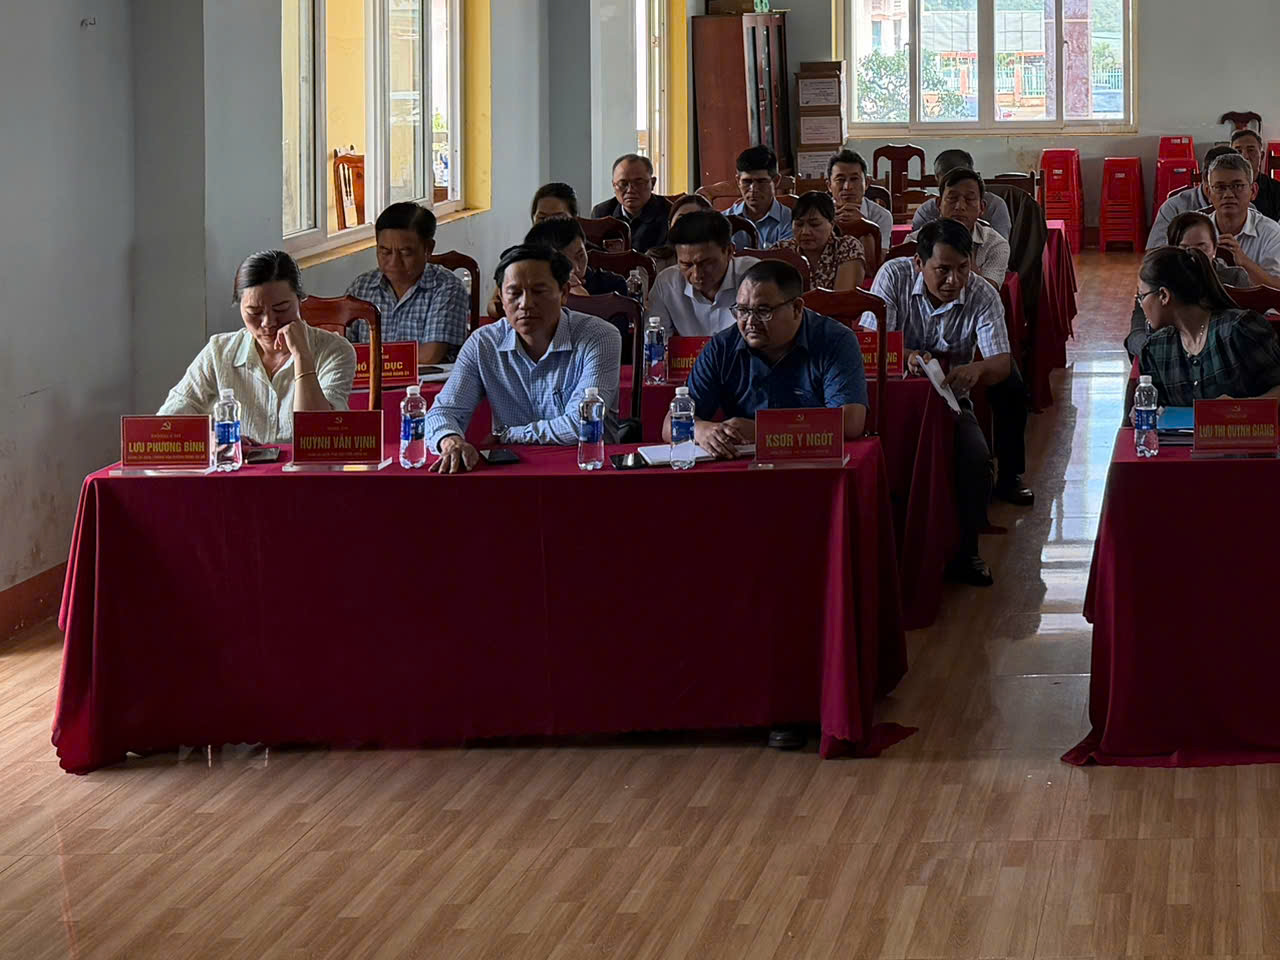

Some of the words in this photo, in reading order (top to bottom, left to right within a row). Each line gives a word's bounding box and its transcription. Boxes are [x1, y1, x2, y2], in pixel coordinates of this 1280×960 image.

[146, 441, 182, 453] PHƯƠNG
[183, 439, 205, 453] BÌNH
[796, 432, 803, 448] Y
